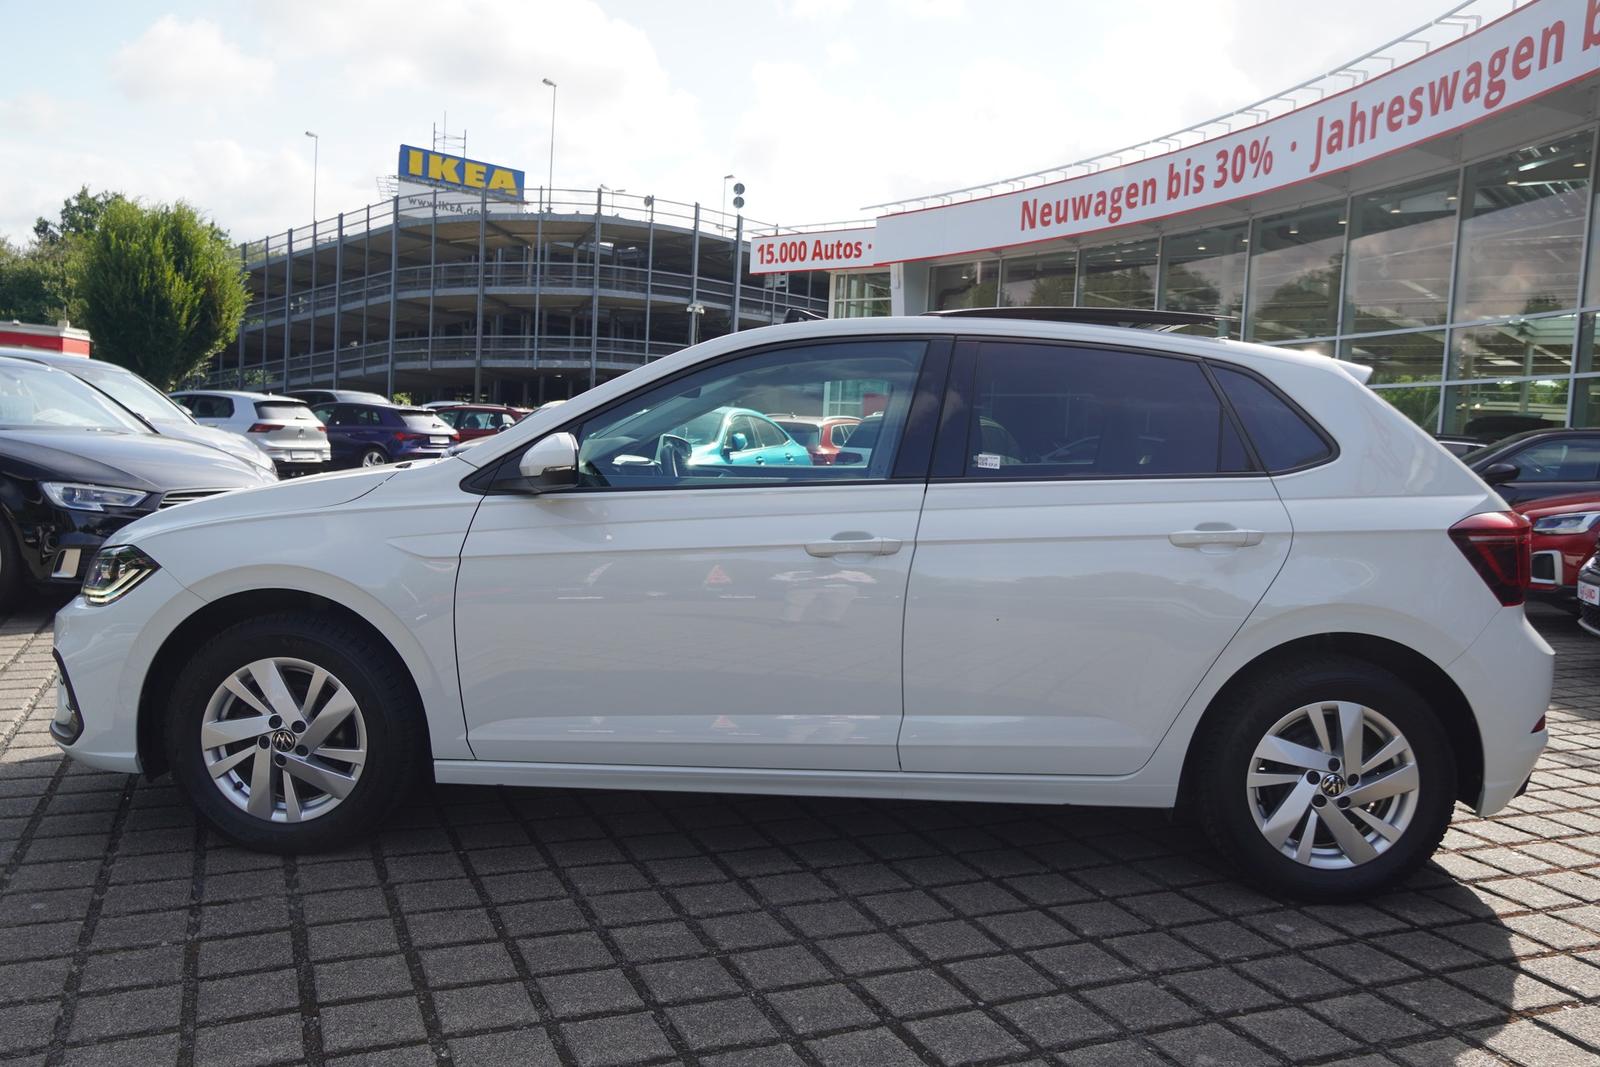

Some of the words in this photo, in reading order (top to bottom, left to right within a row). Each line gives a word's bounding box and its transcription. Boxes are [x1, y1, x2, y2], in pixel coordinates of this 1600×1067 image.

[1020, 174, 1157, 231] Neuwagen
[1166, 157, 1206, 201] bis
[1212, 135, 1273, 189] 30%
[1309, 20, 1565, 173] Jahreswagen
[408, 150, 518, 196] IKEA
[757, 240, 808, 265] 15.000
[811, 239, 863, 261] Autos
